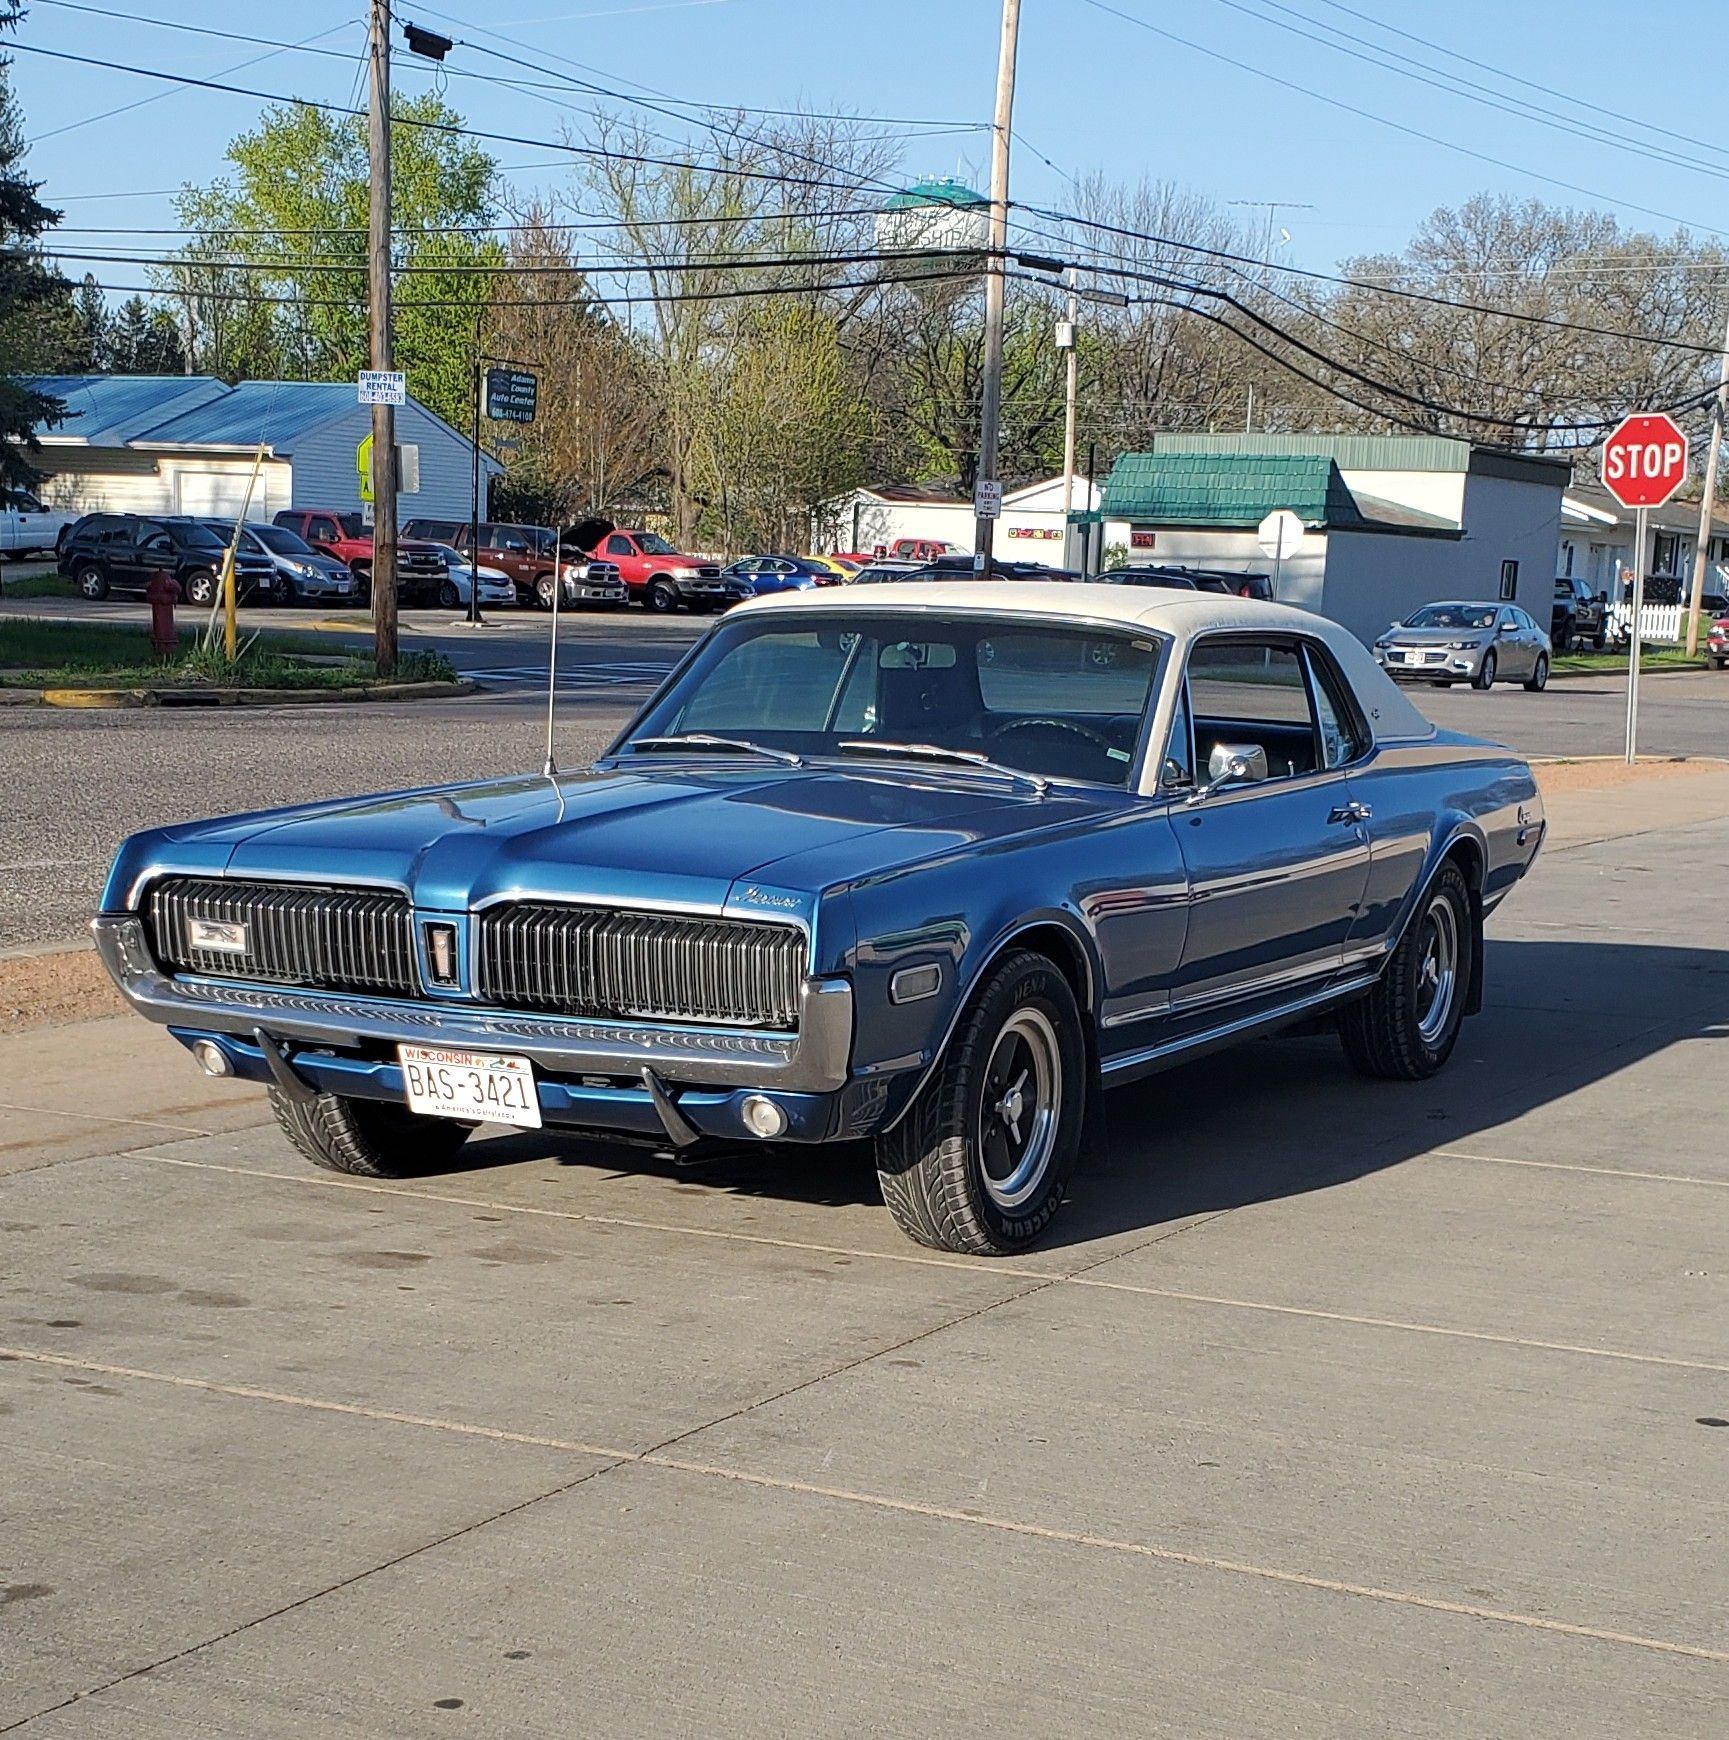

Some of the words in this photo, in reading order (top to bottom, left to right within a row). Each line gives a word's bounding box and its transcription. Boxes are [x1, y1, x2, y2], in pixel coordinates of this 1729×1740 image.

[360, 372, 403, 382] DUMPSTER
[510, 374, 536, 385] Adams
[366, 382, 397, 391] RENTAL
[510, 384, 535, 396] County
[490, 392, 509, 403] Auto
[509, 395, 536, 406] Center
[1607, 443, 1681, 479] STOP
[984, 482, 994, 491] NO
[404, 1048, 473, 1066] WISCONSIN
[407, 1064, 531, 1110] BAS-3421
